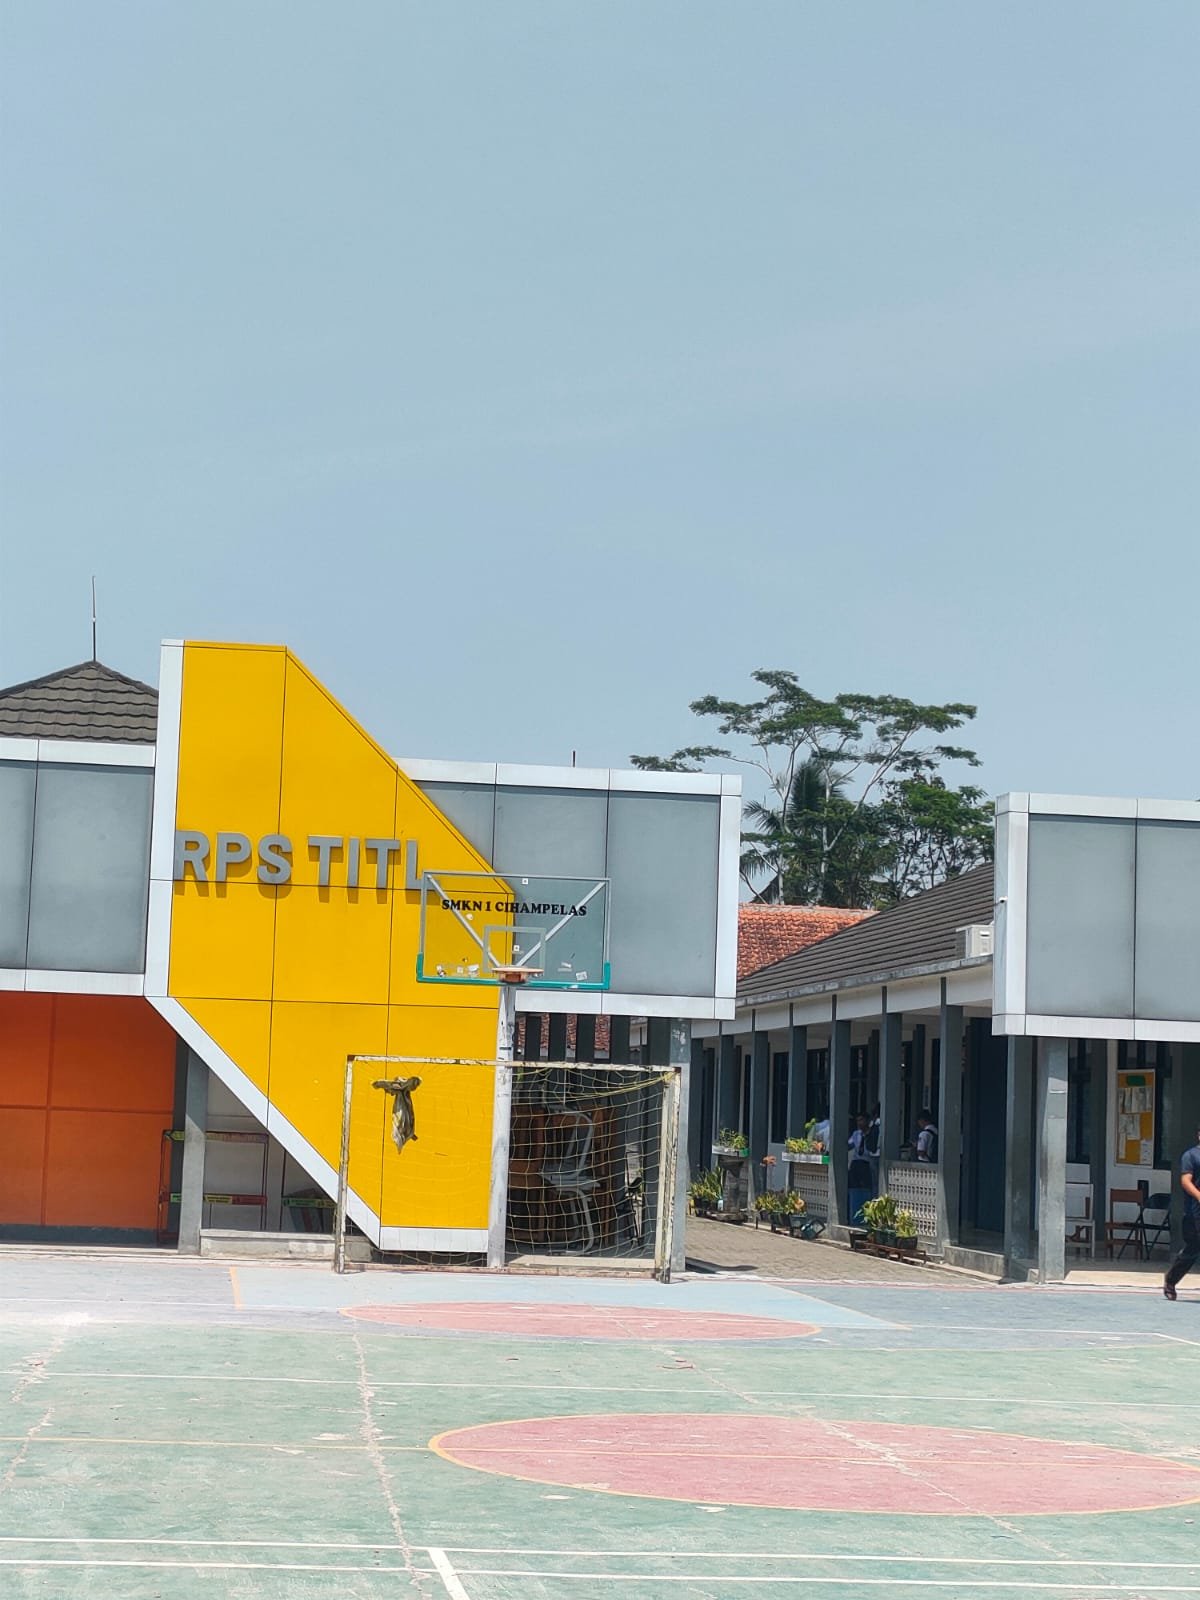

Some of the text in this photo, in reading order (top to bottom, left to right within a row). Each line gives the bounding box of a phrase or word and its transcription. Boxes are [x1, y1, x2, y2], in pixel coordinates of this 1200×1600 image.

[173, 830, 440, 890] RPS TITL
[442, 899, 587, 916] SMKN 1 CIHAMPELAS
